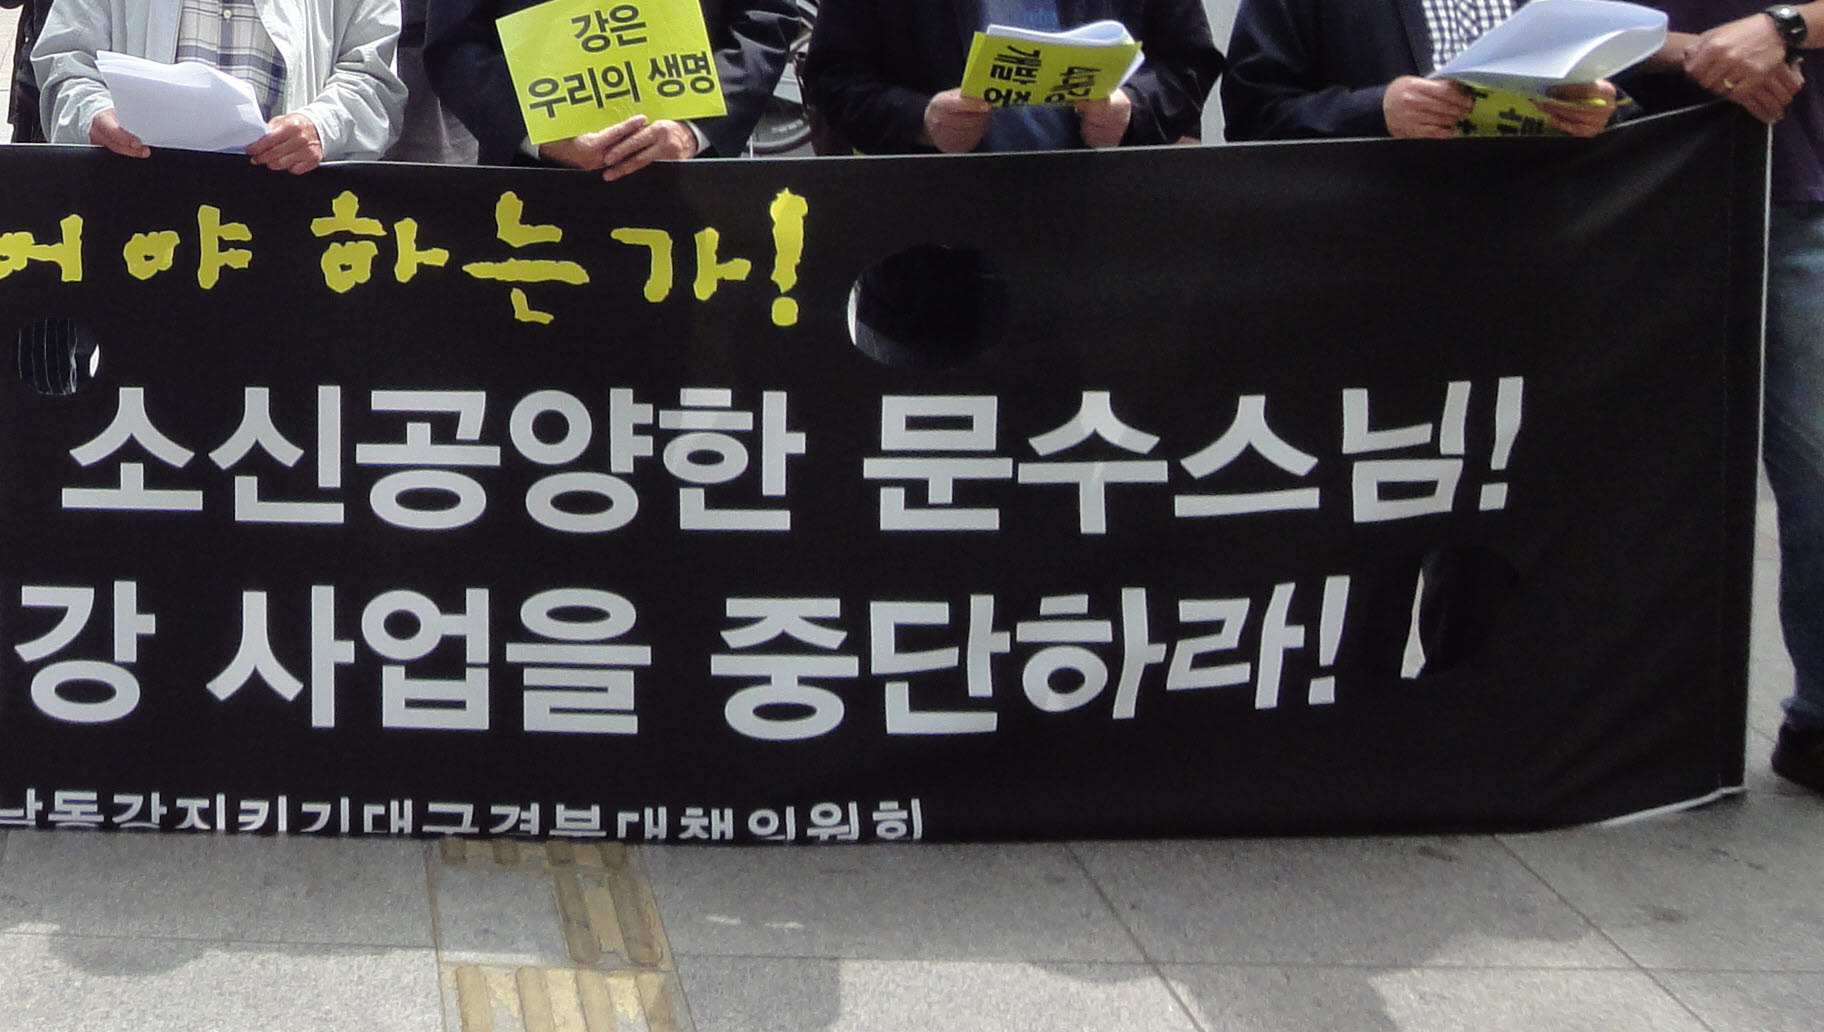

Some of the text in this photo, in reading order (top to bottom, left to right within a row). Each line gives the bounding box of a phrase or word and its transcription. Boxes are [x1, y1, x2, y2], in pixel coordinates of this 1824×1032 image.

[529, 51, 715, 118] 우리의 생명
[571, 4, 648, 53] 강은
[311, 188, 808, 326] 하는가!
[62, 383, 806, 532] 소신공양한
[863, 377, 1523, 533] 문수스님!
[206, 585, 651, 734] 사업을
[711, 576, 1350, 740] 중단하라!
